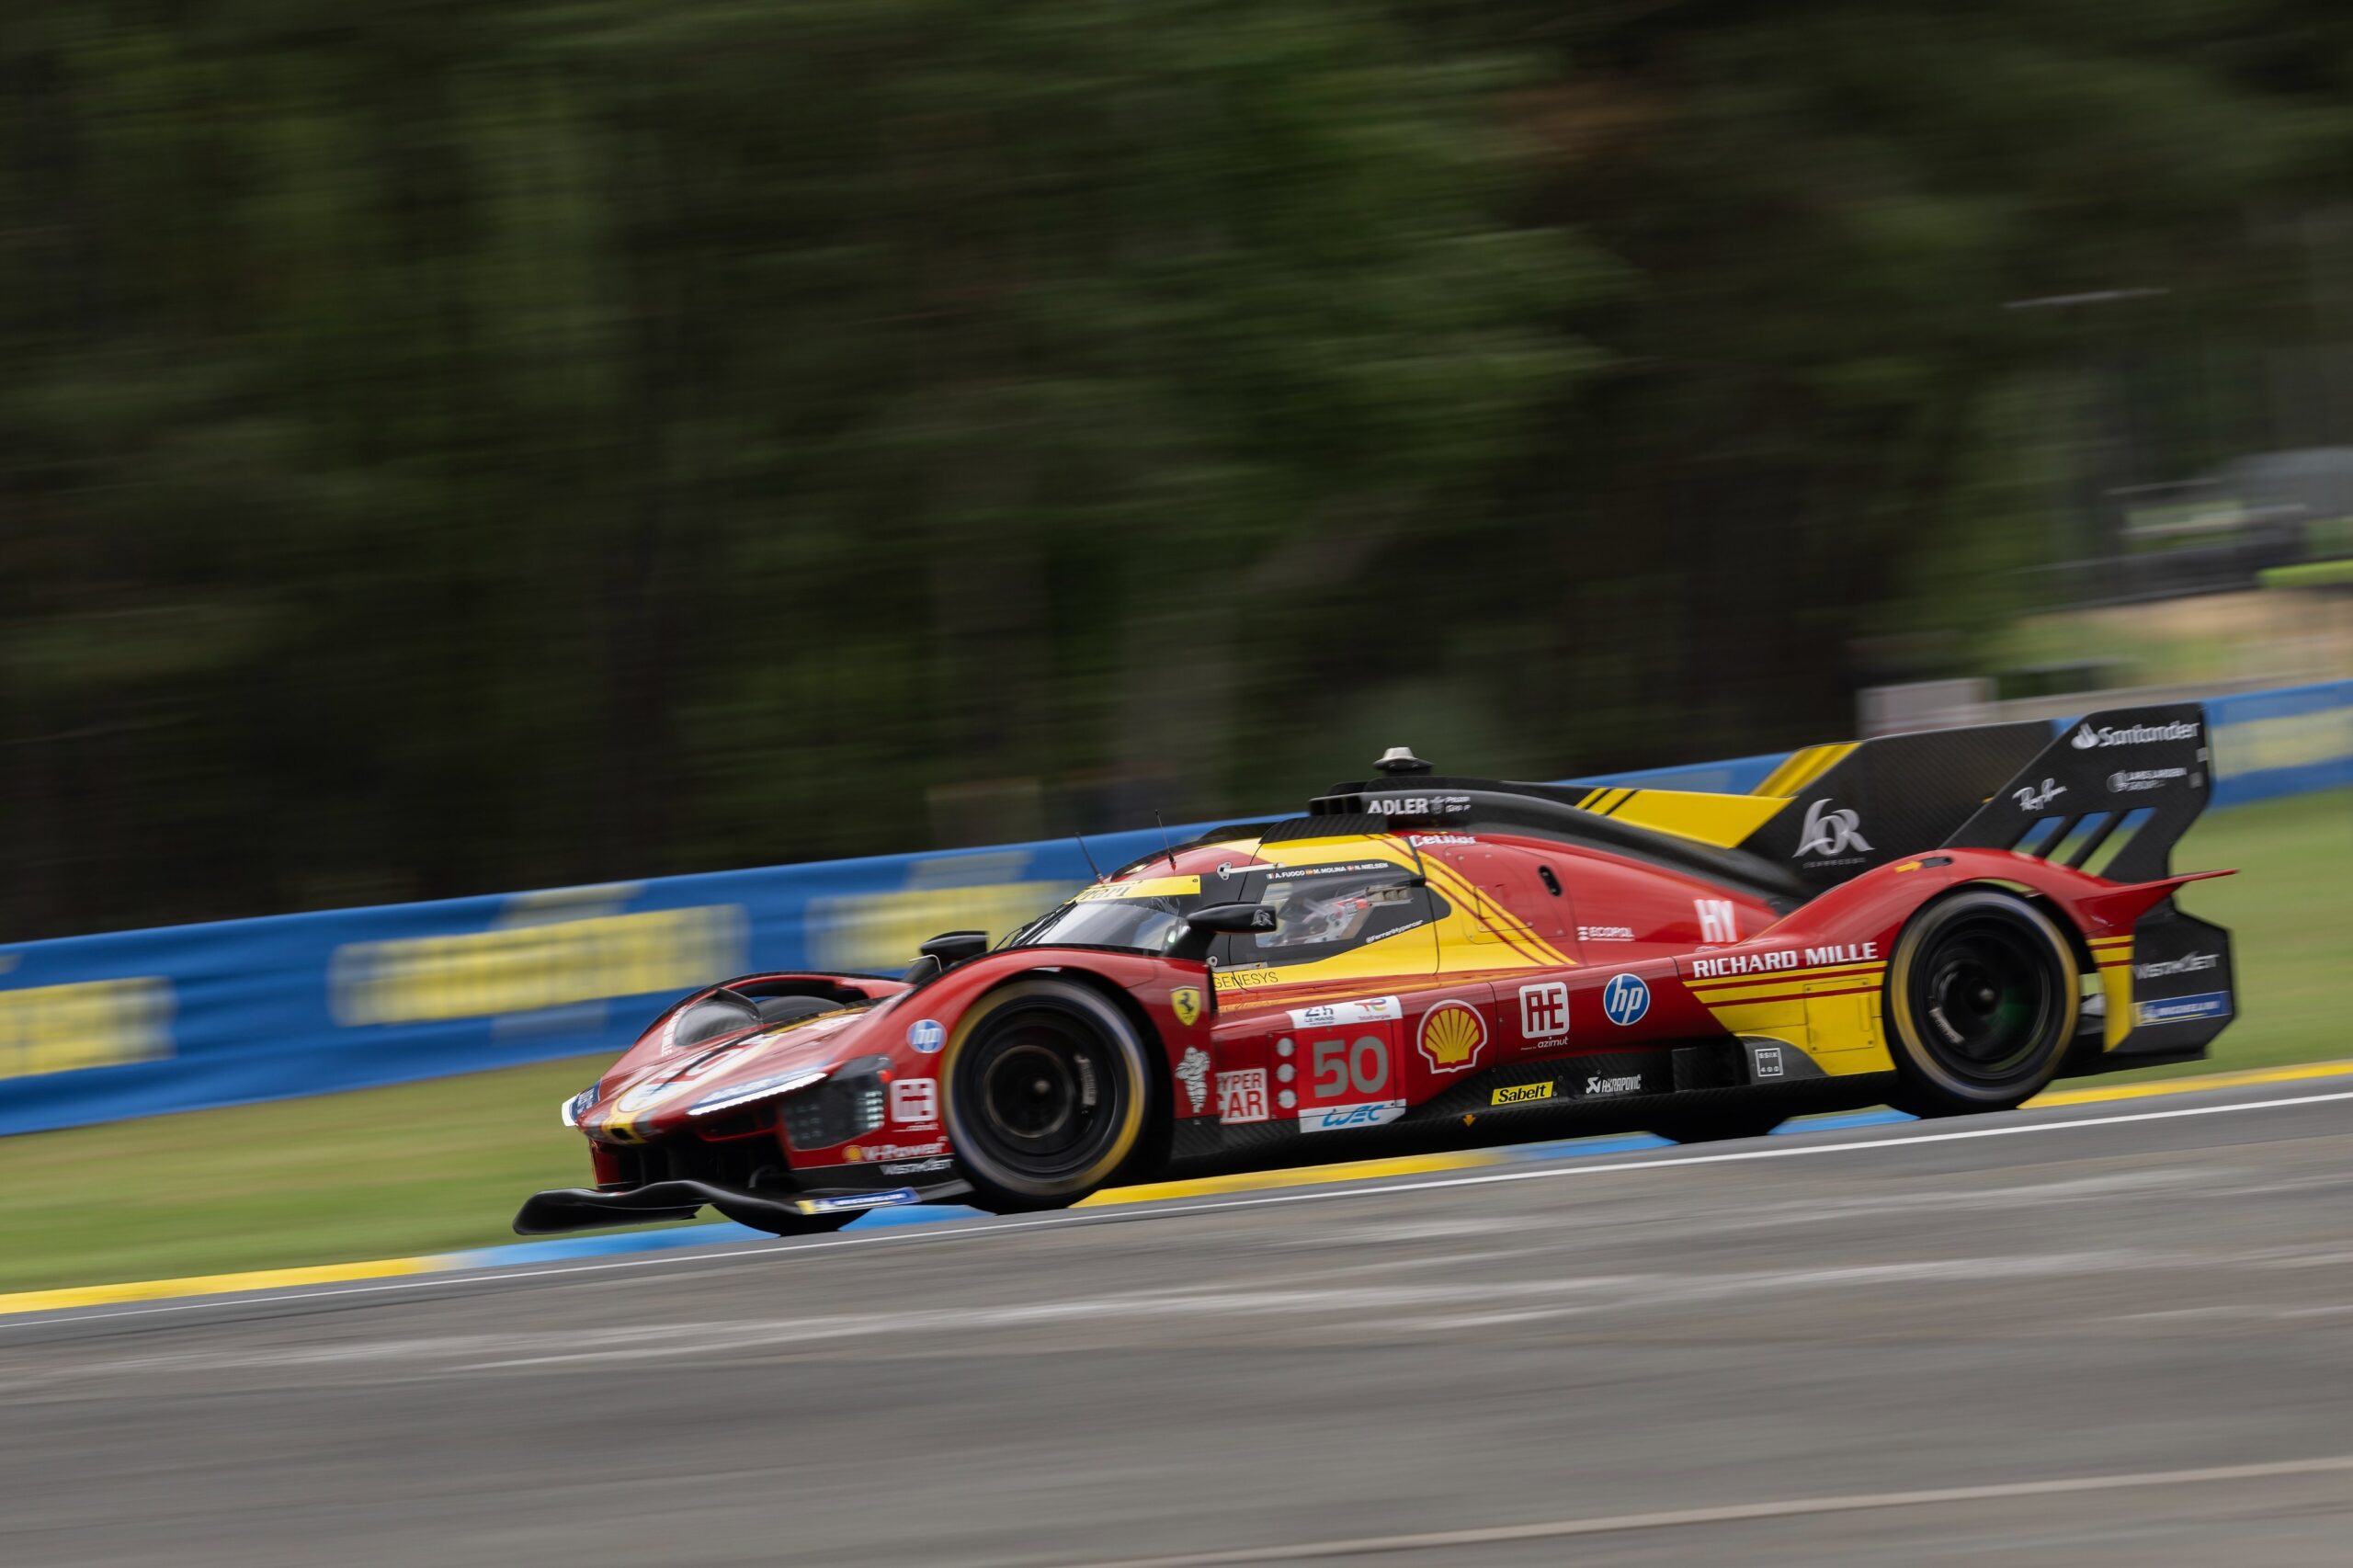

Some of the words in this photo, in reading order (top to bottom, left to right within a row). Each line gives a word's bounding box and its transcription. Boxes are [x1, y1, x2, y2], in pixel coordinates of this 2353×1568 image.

[2097, 722, 2200, 747] Santander
[1367, 798, 1429, 815] ADLER
[1409, 835, 1476, 847] Cetilar
[1588, 926, 1635, 938] ECOPOL
[1692, 949, 1797, 978] RICHARD
[1804, 941, 1879, 966] MILLE
[1214, 971, 1279, 989] GENESYS
[1609, 975, 1644, 1025] hp
[1537, 1036, 1569, 1049] azimut
[1313, 1036, 1389, 1098] 50
[1498, 1084, 1546, 1103] Sabelt
[1322, 1105, 1384, 1127] WEC
